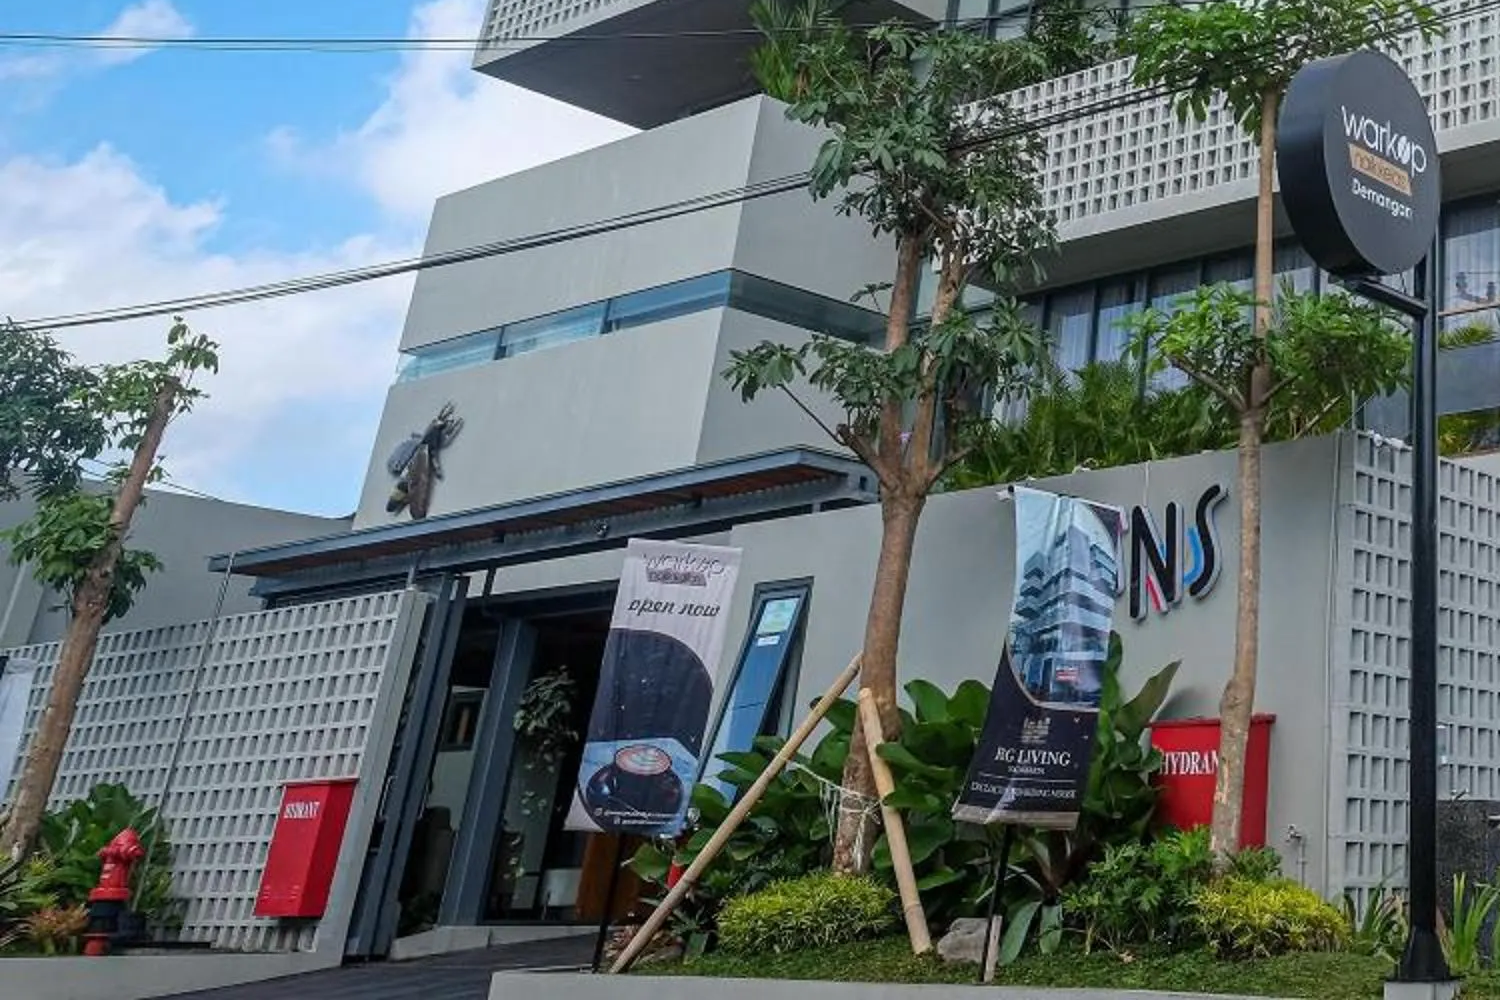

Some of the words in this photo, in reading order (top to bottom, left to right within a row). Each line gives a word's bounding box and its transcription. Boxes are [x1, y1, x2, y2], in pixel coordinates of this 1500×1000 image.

[1115, 483, 1229, 622] NS
[627, 599, 675, 616] open
[678, 603, 721, 617] now
[1016, 749, 1071, 767] LIVING
[1159, 750, 1220, 775] HYDRAN
